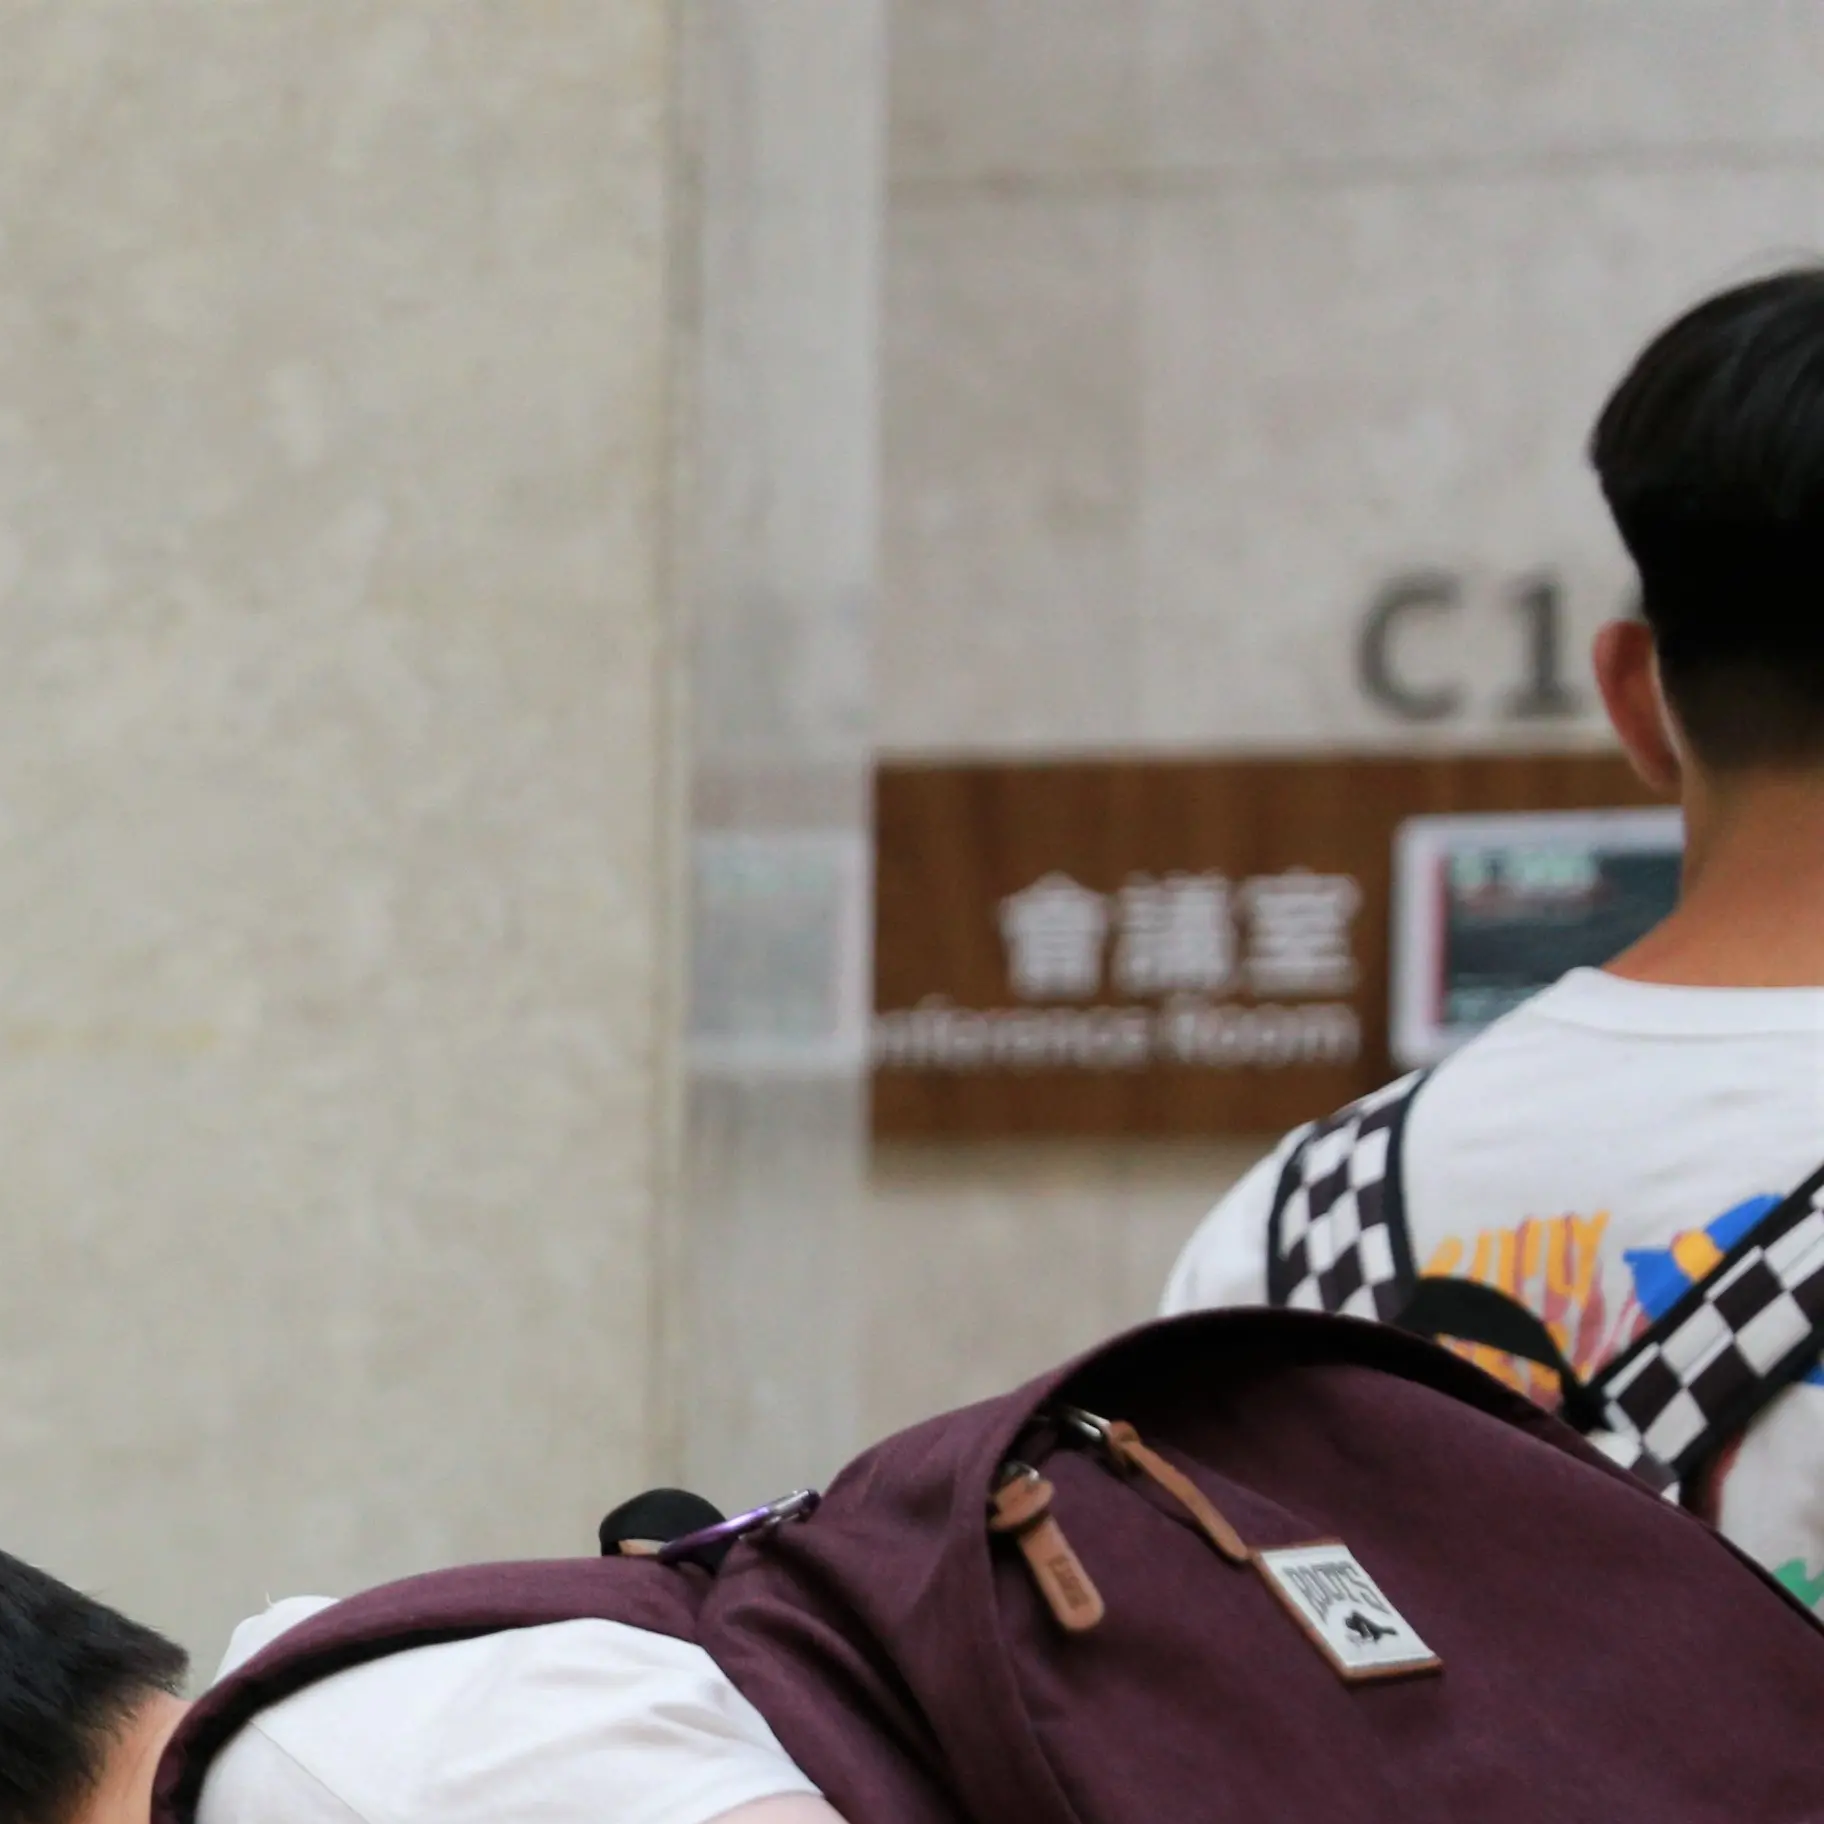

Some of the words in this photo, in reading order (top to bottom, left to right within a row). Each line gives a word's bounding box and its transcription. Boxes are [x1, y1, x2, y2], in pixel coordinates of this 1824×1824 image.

[1360, 571, 1592, 720] C1
[1002, 873, 1359, 996] 會議室
[874, 996, 1150, 1068] nference
[1164, 996, 1360, 1066] Room
